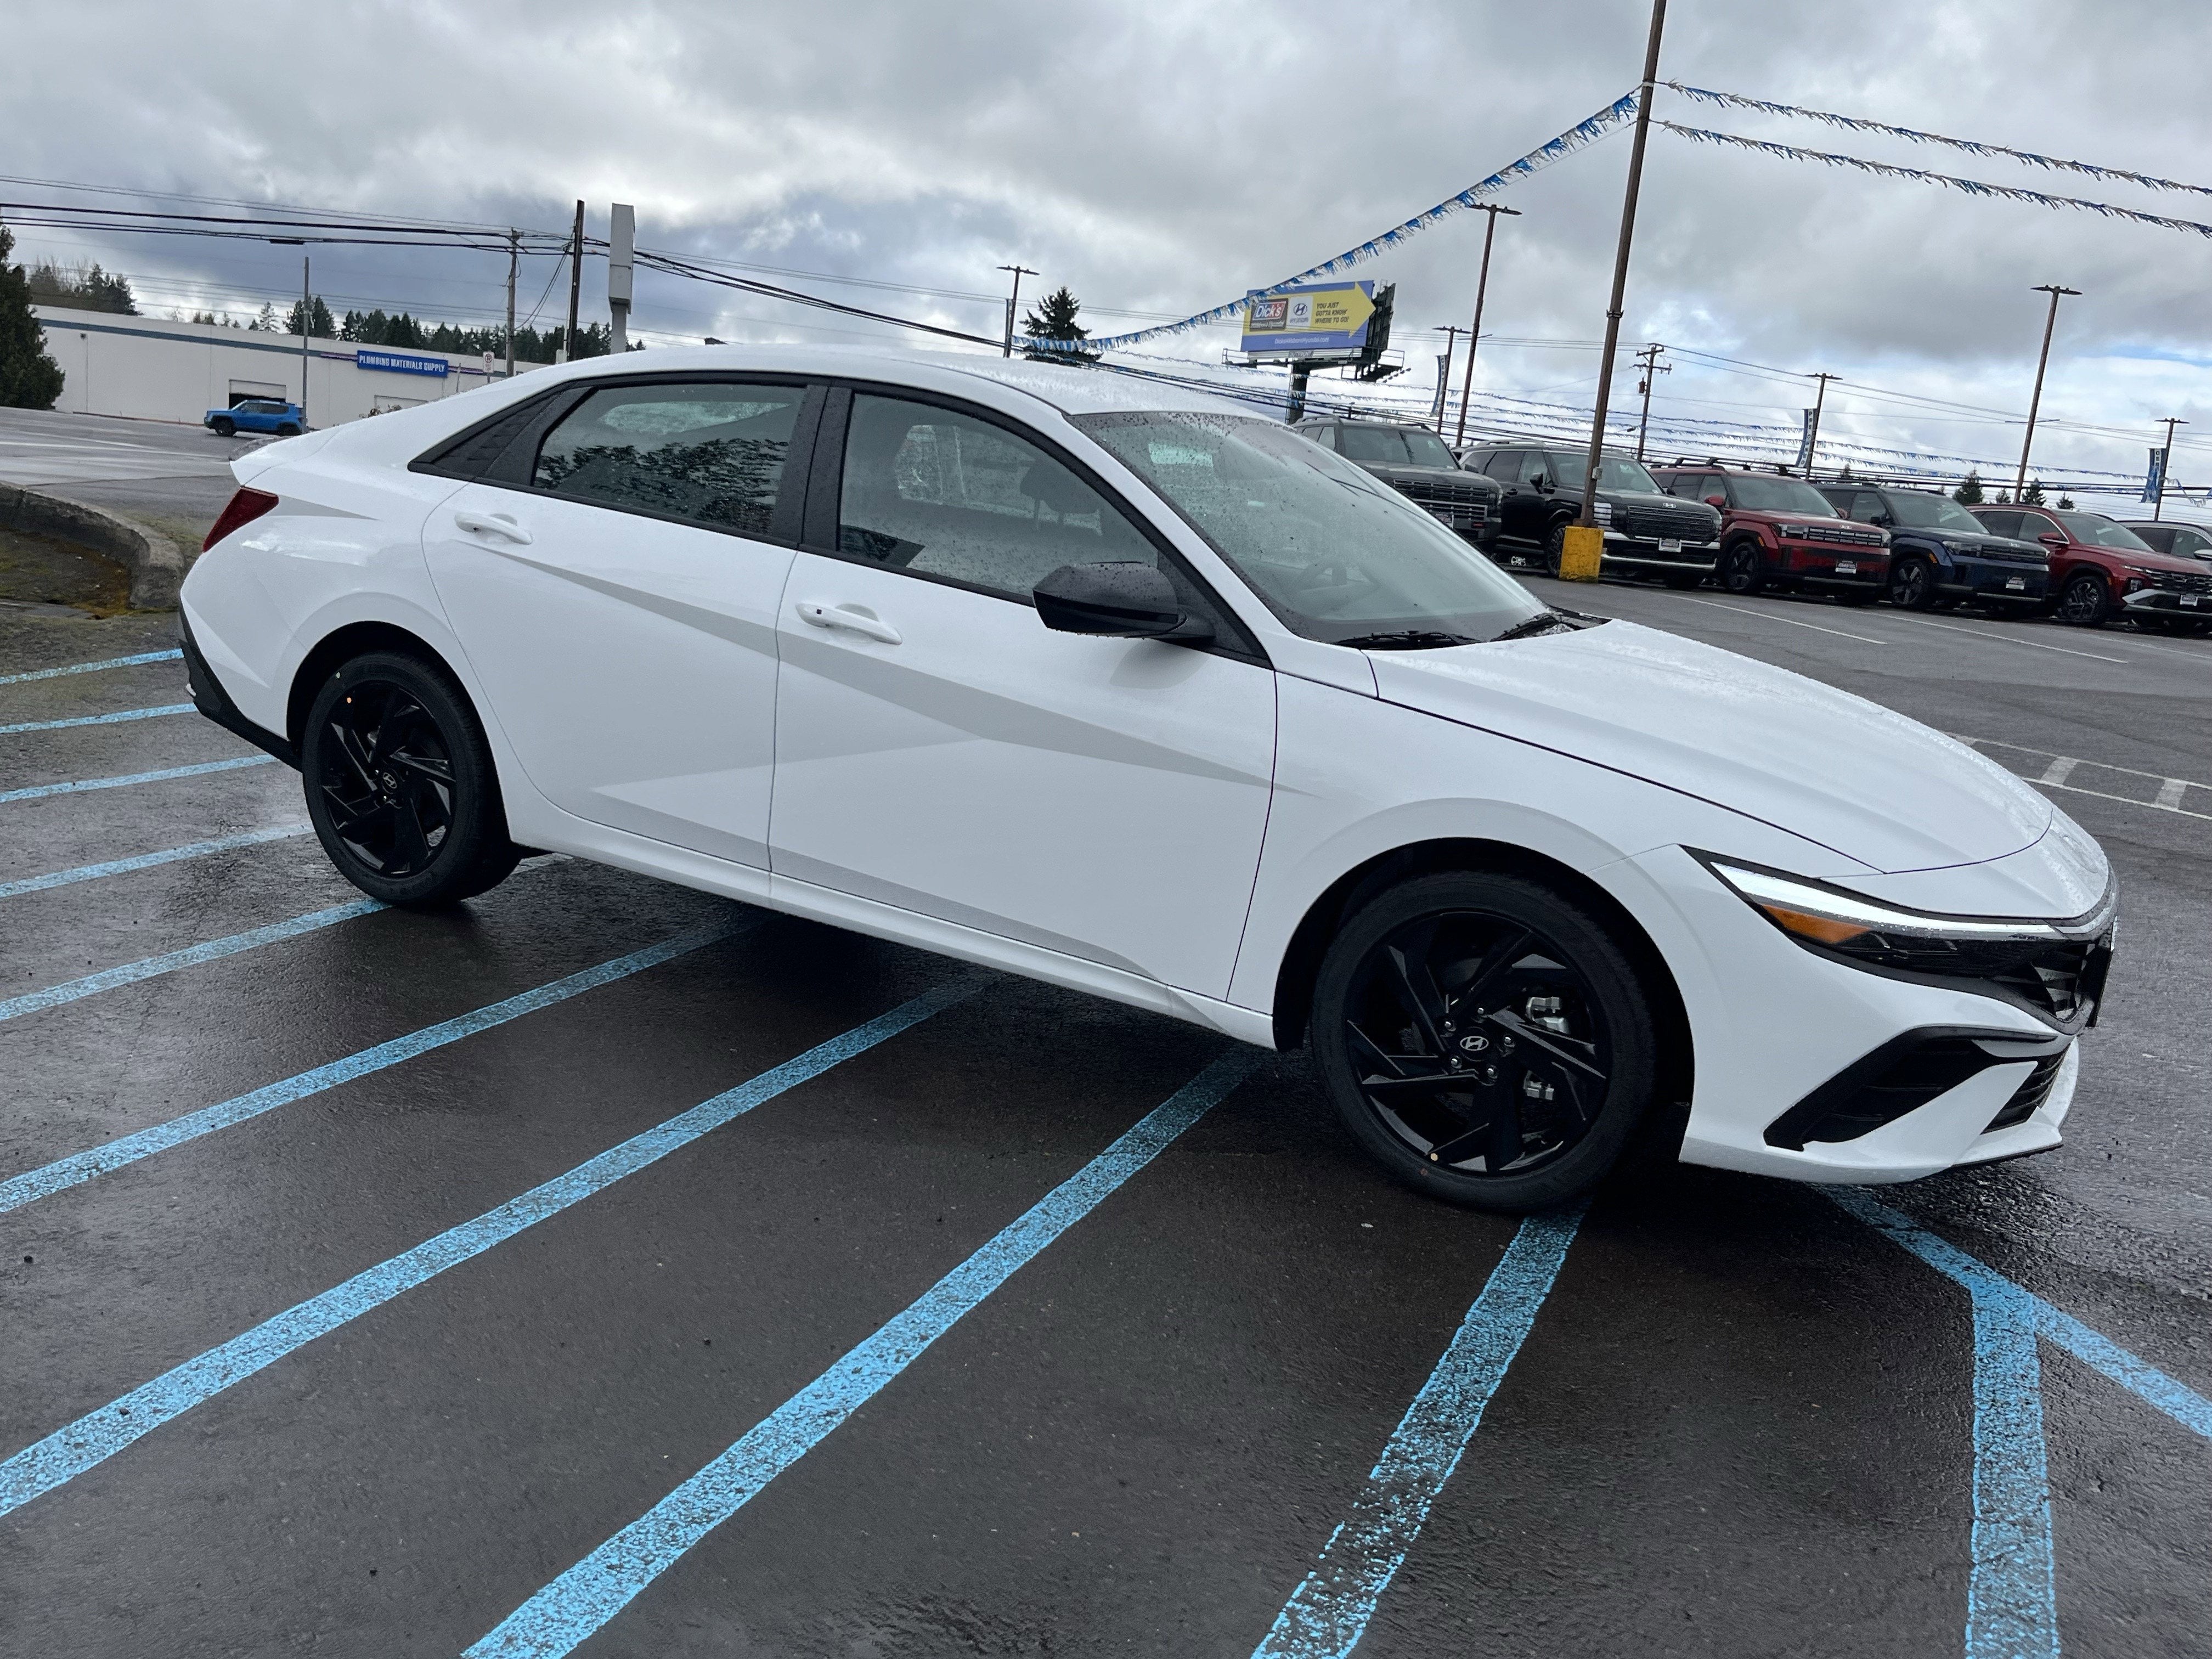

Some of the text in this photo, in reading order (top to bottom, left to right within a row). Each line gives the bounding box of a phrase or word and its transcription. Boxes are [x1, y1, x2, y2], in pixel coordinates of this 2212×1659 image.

[359, 355, 445, 373] PLUMBING MATERIALS SUPPLY
